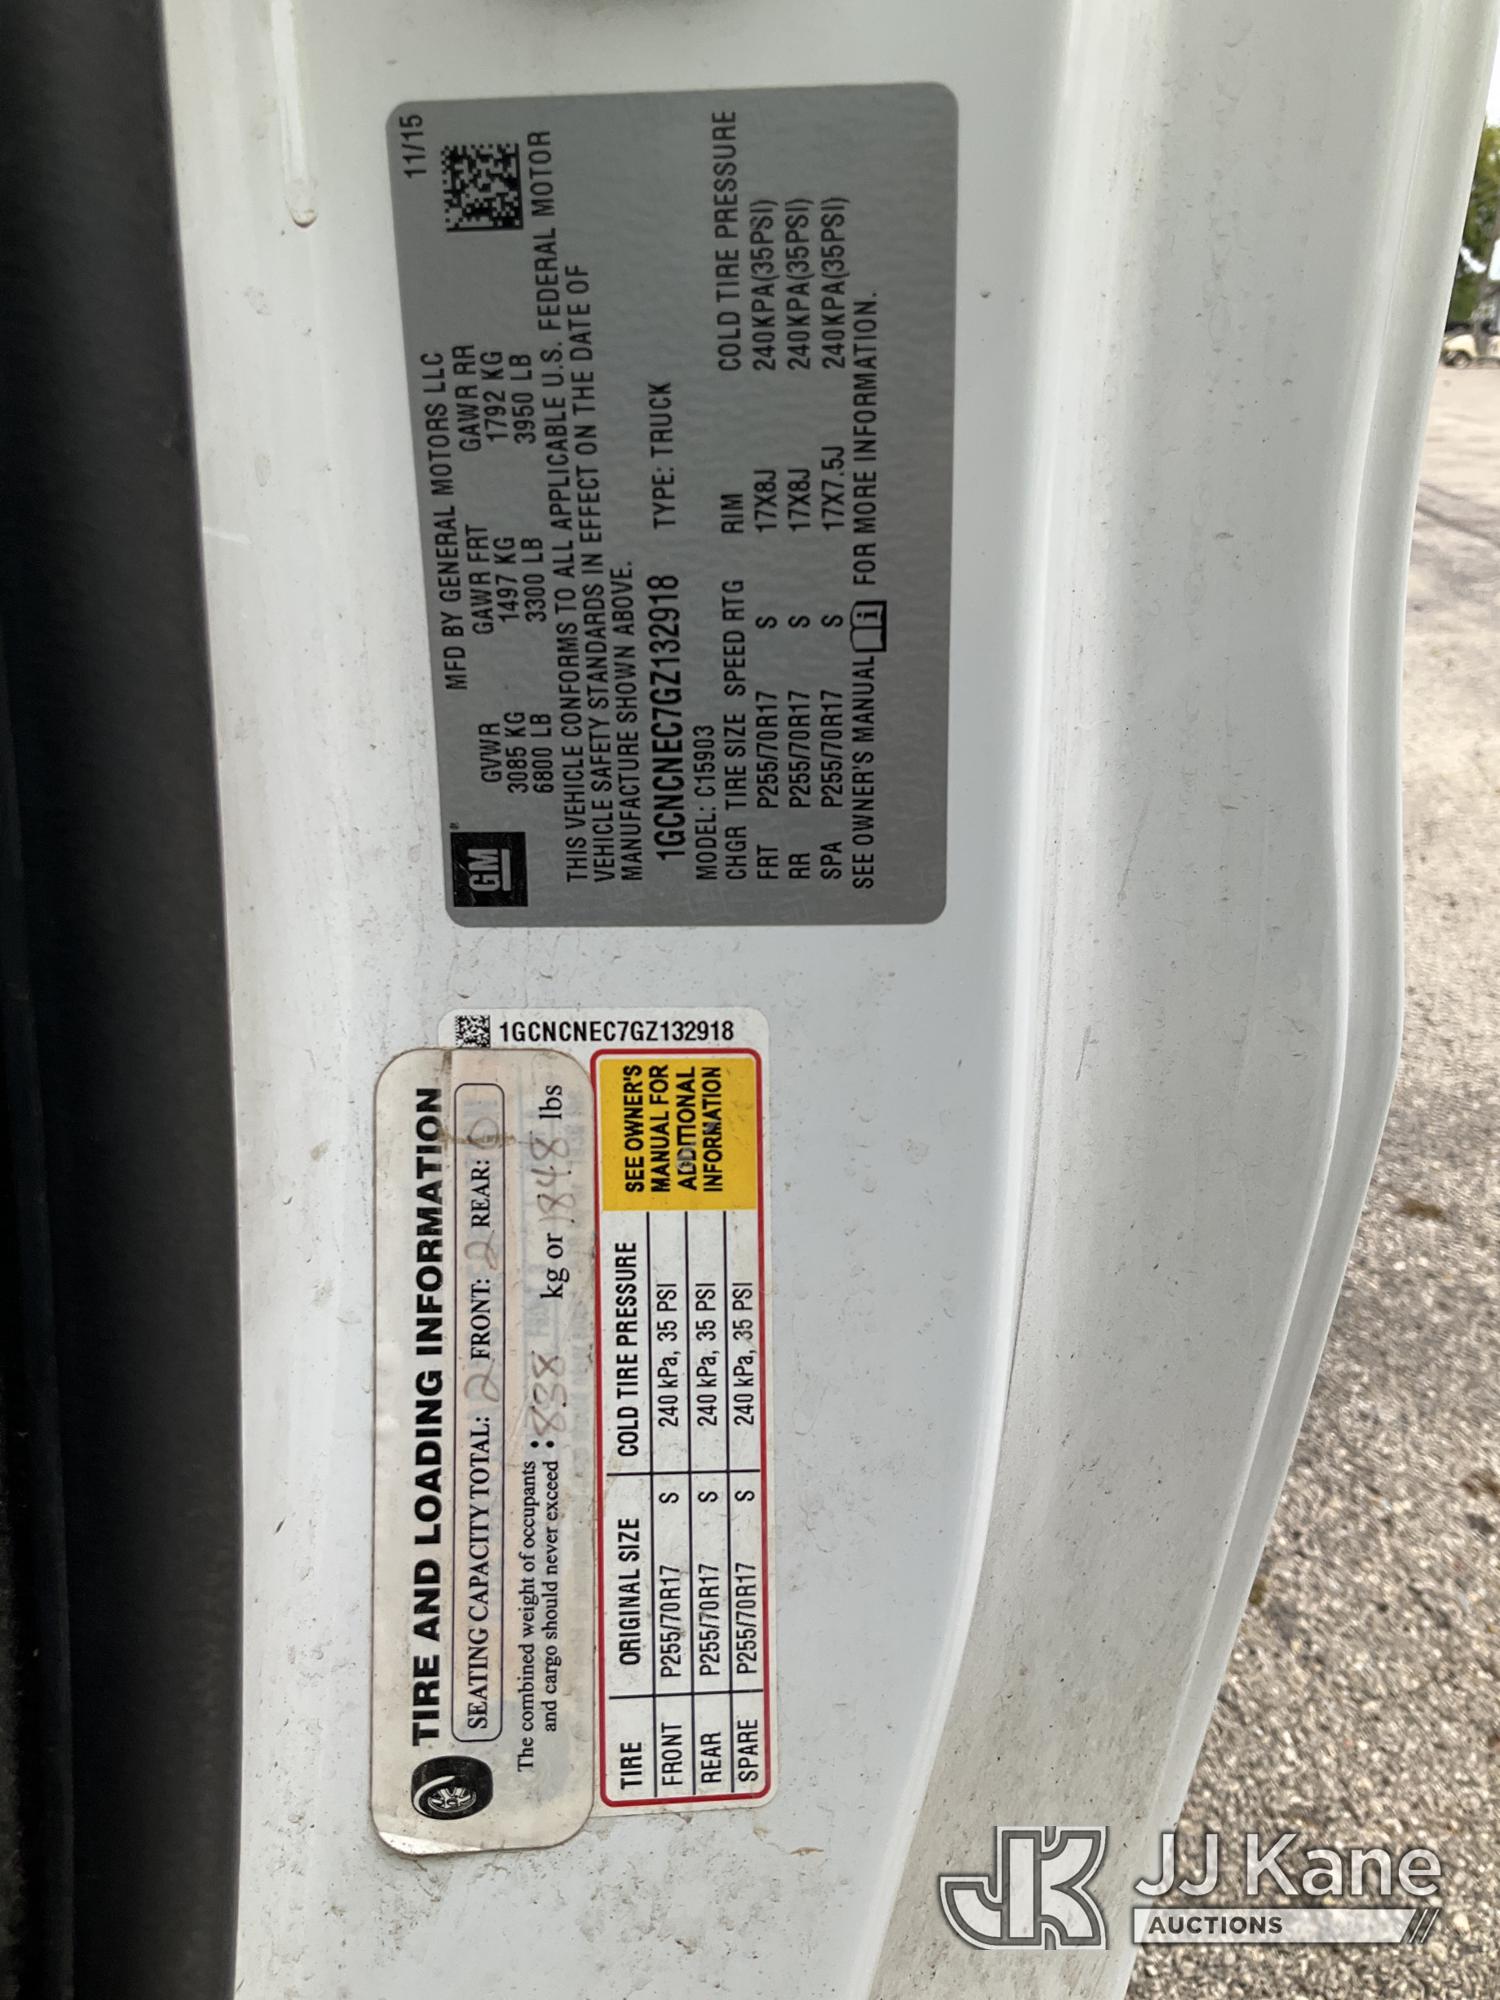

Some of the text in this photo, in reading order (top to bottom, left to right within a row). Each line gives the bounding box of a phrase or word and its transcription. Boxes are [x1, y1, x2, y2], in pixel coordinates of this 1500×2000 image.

[399, 114, 426, 179] 11/15
[712, 111, 741, 371] COLD TIRE PRESSURE
[749, 199, 780, 371] 240KPA(35PSI)
[785, 198, 815, 370] 240KPA(35PSI)
[821, 197, 850, 369] 240KPA(35PSI)
[452, 344, 481, 451] GAWR RR
[481, 351, 509, 442] 1792 KG
[510, 354, 536, 444] 3950 LB
[853, 292, 878, 585] FOR MORE INFORMATION.
[527, 131, 588, 882] THIS VEHICLE CONFORMS TO ALL APPLICABLE U.S. FEDERAL MOTOR
[648, 382, 675, 529] TYPE: TRUCK
[721, 493, 744, 534] RIM
[754, 469, 777, 533] 17X8J
[787, 468, 811, 532] 17X8J
[822, 446, 845, 531] 17X7.5J
[421, 352, 467, 690] MFD BY GENERAL MOTORS LLC
[466, 523, 494, 635] GAWR FRT
[494, 537, 519, 622] 1497 KG
[565, 264, 616, 882] VEHICLE SAFETY STANDARDS IN EFFECT ON THE DATE OF
[521, 537, 547, 623] 3300 LB
[721, 580, 746, 697] SPEED RTG
[755, 616, 777, 629] S
[788, 615, 810, 628] S
[821, 614, 843, 627] S
[479, 722, 501, 783] GVWR
[504, 711, 528, 794] 3085 KG
[531, 713, 554, 794] 6800 LB
[611, 561, 643, 881] MANUFACTURE SHOWN ABOVE.
[647, 575, 686, 861] 1GCNCNEC7GZ132918
[724, 713, 746, 810] TIRE SIZE
[755, 691, 779, 808] P255/70R17
[788, 690, 811, 808] P255/70R17
[820, 690, 843, 807] P255/70R17
[853, 655, 875, 889] SEE OWNER'S MANUAL
[693, 724, 717, 880] MODEL: C15903
[725, 825, 747, 880] CHGR
[821, 841, 842, 880] SPA
[468, 848, 500, 892] GM
[757, 844, 779, 879] FRT
[789, 853, 810, 879] RR
[499, 1020, 734, 1042] 1GCNCNEC7GZ132918
[539, 1085, 562, 1120] lbs
[623, 1065, 644, 1192] SEE OWNER'S
[649, 1065, 670, 1192] MANUAL FOR
[675, 1066, 697, 1191] ADDITIONAL
[702, 1066, 723, 1192] INFORMATION
[471, 1159, 491, 1228] REAR:
[471, 1278, 491, 1360] FRONT:
[541, 1232, 569, 1299] kg or
[614, 1242, 639, 1457] COLD TIRE PRESSURE
[656, 1283, 680, 1427] 240 kPa, 35 PSI
[695, 1282, 720, 1426] 240 kPa, 35 PSI
[732, 1282, 757, 1426] 240 kPa, 35 PSI
[412, 1087, 443, 1746] TIRE AND LOADING INFORMATION
[468, 1417, 490, 1729] SEATING CAPACITY TOTAL:
[517, 1461, 540, 1772] The combined weight of occupants
[541, 1461, 561, 1732] and cargo should never exceed
[618, 1518, 641, 1665] ORIGINAL SIZE
[659, 1492, 681, 1678] P255/70R17 S
[698, 1491, 720, 1676] P255/70R17 S
[735, 1490, 758, 1674] P255/70R17 S
[620, 1742, 642, 1789] TIRE
[661, 1722, 682, 1786] FRONT
[701, 1732, 722, 1783] REAR
[738, 1719, 759, 1782] SPARE
